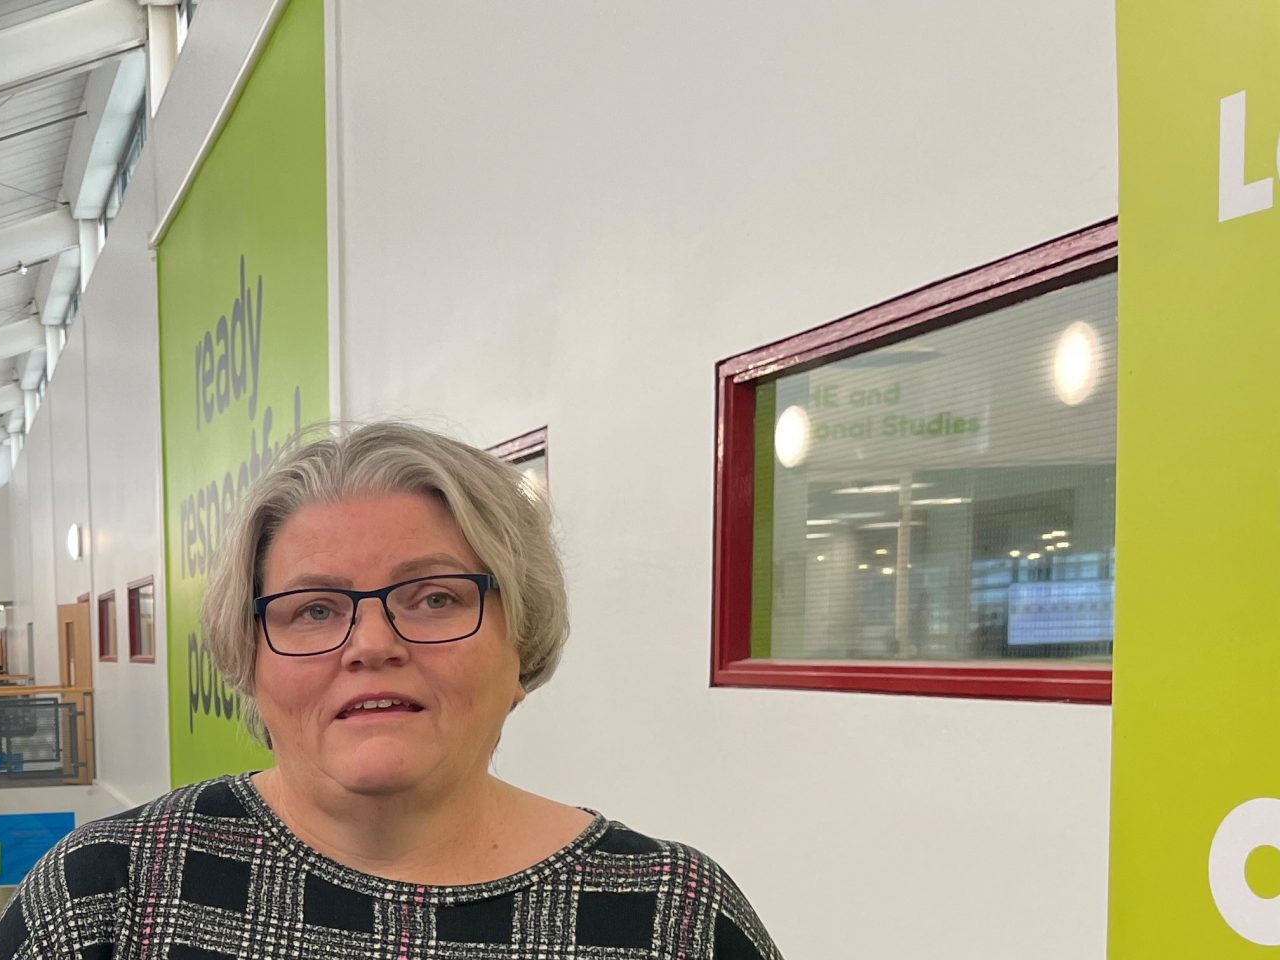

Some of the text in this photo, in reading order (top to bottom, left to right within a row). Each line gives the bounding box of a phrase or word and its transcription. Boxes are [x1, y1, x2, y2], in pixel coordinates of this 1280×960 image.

[194, 253, 263, 431] ready
[849, 381, 901, 406] and
[880, 410, 981, 437] Studies
